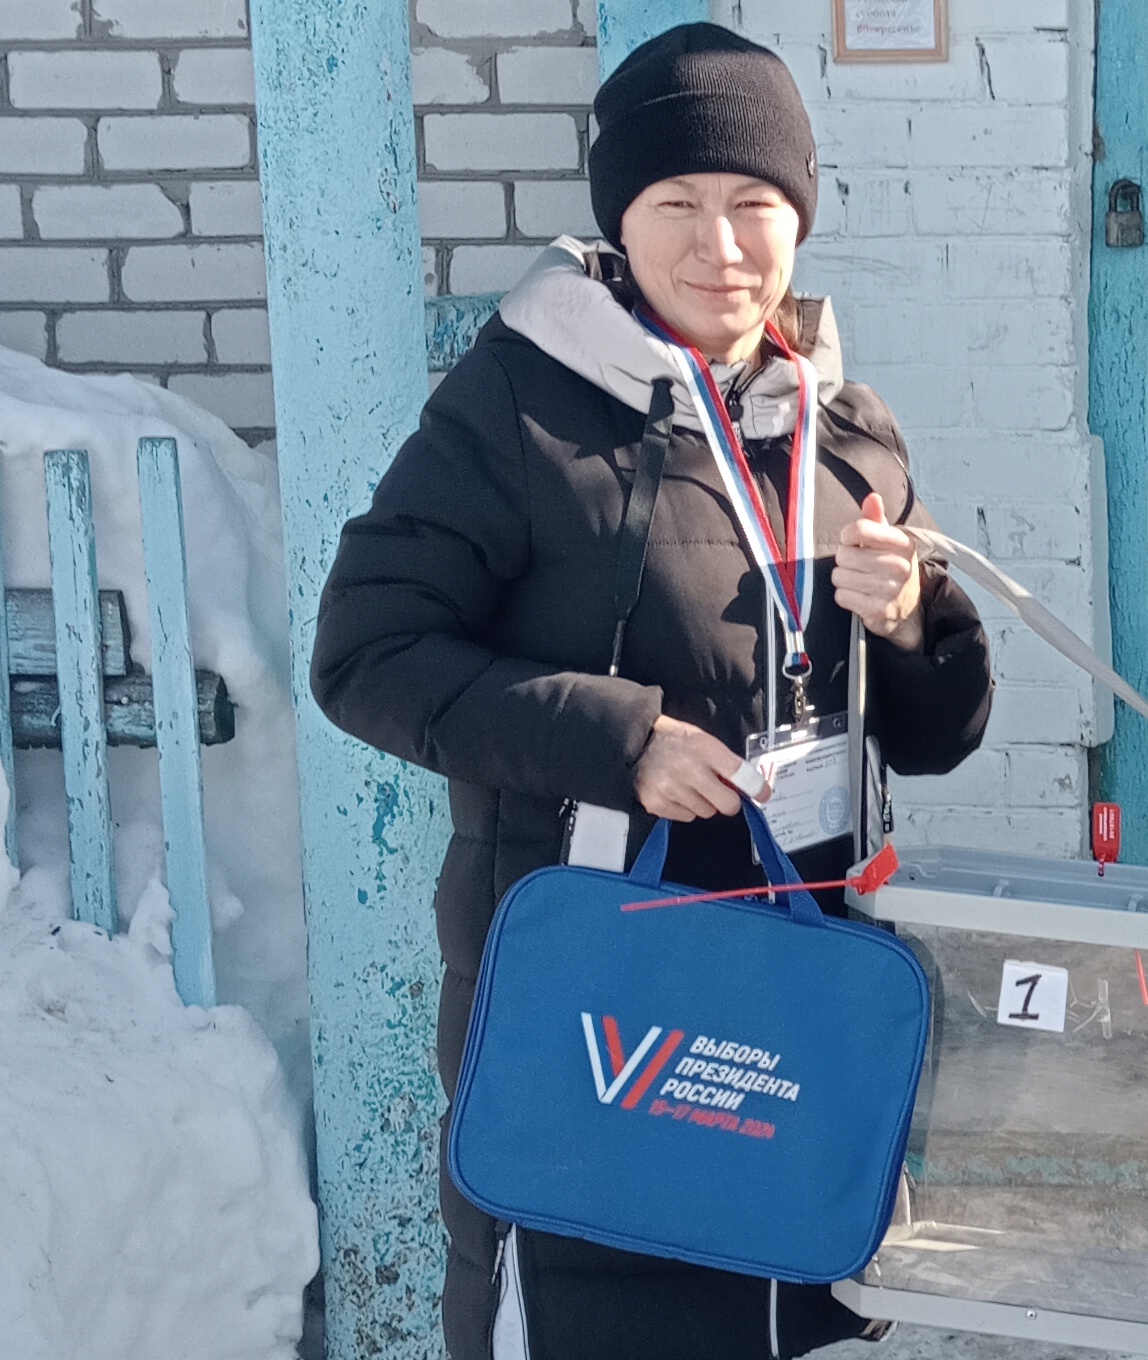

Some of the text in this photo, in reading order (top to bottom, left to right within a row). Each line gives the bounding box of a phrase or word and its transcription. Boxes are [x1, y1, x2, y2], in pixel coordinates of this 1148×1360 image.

[1008, 973, 1042, 1021] 1
[689, 1034, 781, 1071] ВЫБОРЫ
[659, 1077, 746, 1111] РОССИИ
[674, 1056, 801, 1102] ПРЕЗИДЕНТА
